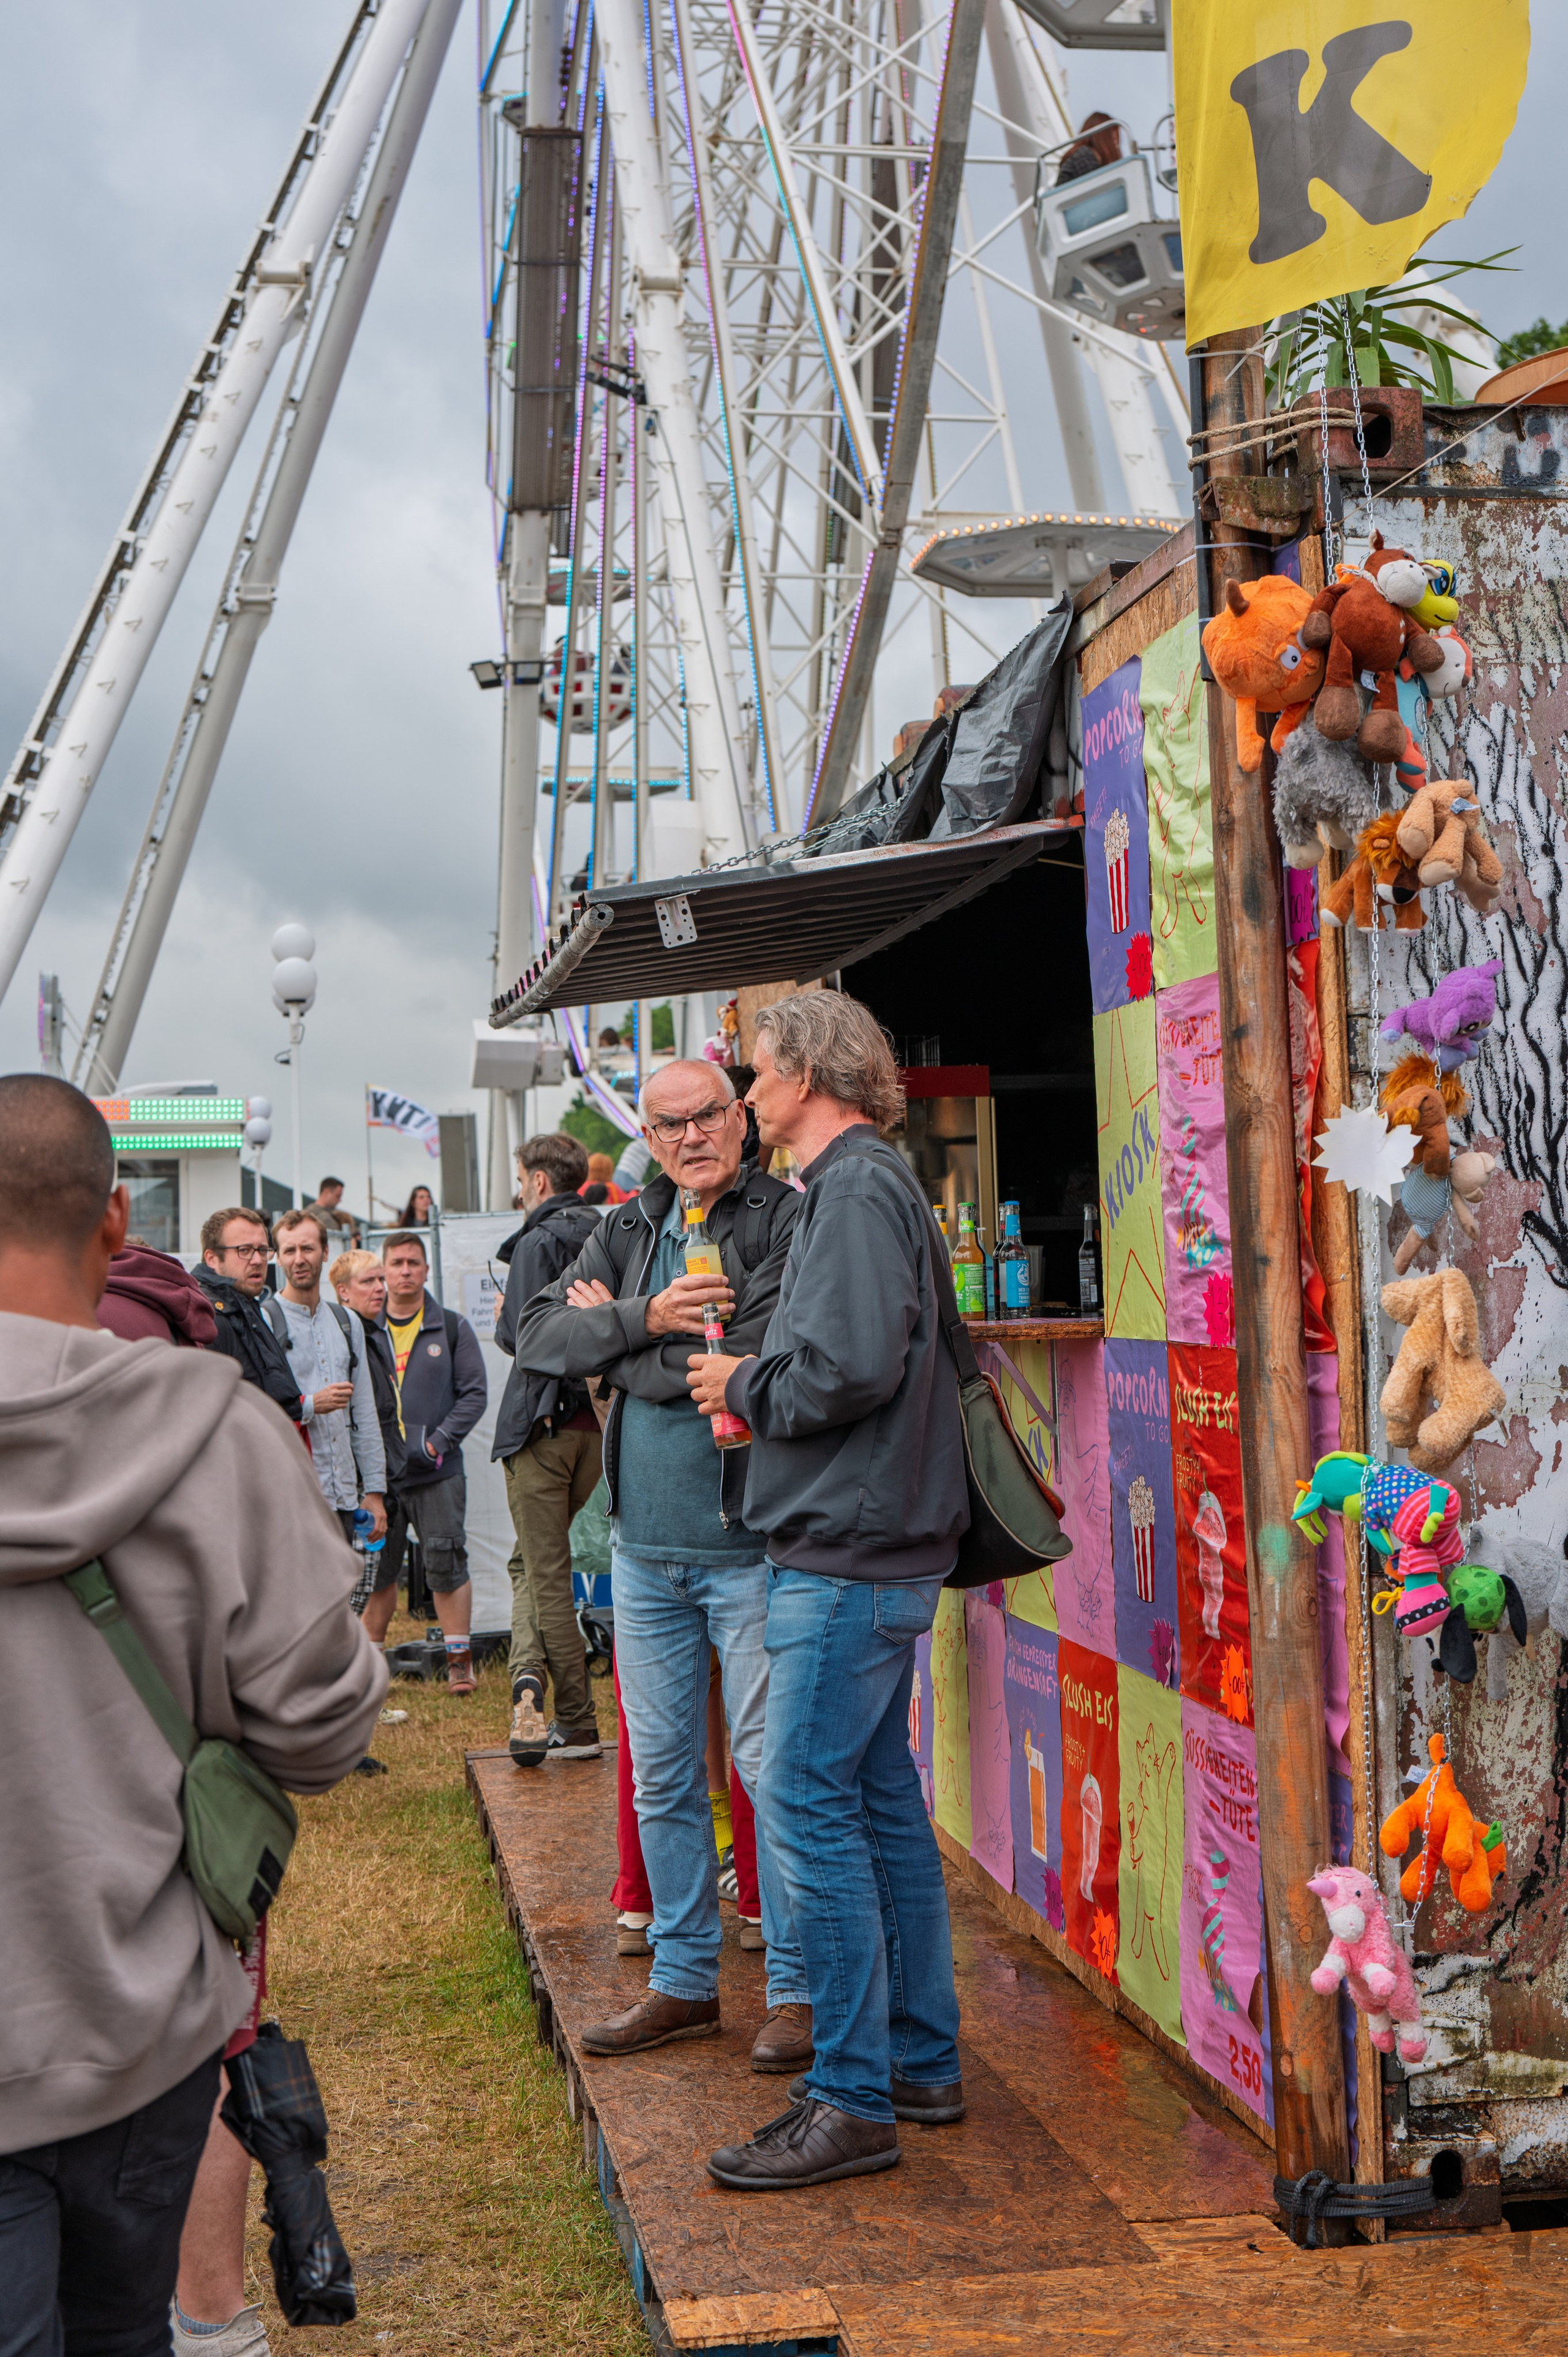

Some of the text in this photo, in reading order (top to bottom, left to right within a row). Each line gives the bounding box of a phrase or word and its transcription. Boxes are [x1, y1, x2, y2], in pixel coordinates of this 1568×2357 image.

[1230, 20, 1432, 264] K
[1085, 689, 1142, 766] POPCORN
[1119, 736, 1142, 769] TO GO
[1105, 1104, 1155, 1230] KIOSK
[1108, 1366, 1168, 1419] POPCORN
[1175, 1383, 1209, 1428] SLUSH
[1145, 1422, 1169, 1443] TO GO
[1114, 1442, 1133, 1475] SWEET!
[1177, 1472, 1196, 1493] FRUITY
[1007, 1656, 1058, 1700] ORANGENSAFT
[1022, 1644, 1057, 1672] GEPRESSTER
[1063, 1674, 1114, 1731] SLUSH EIS
[1066, 1749, 1083, 1772] FRUITY
[1185, 1728, 1254, 1799] SÜSSIGKEITEN
[1229, 2034, 1261, 2096] 2,50
